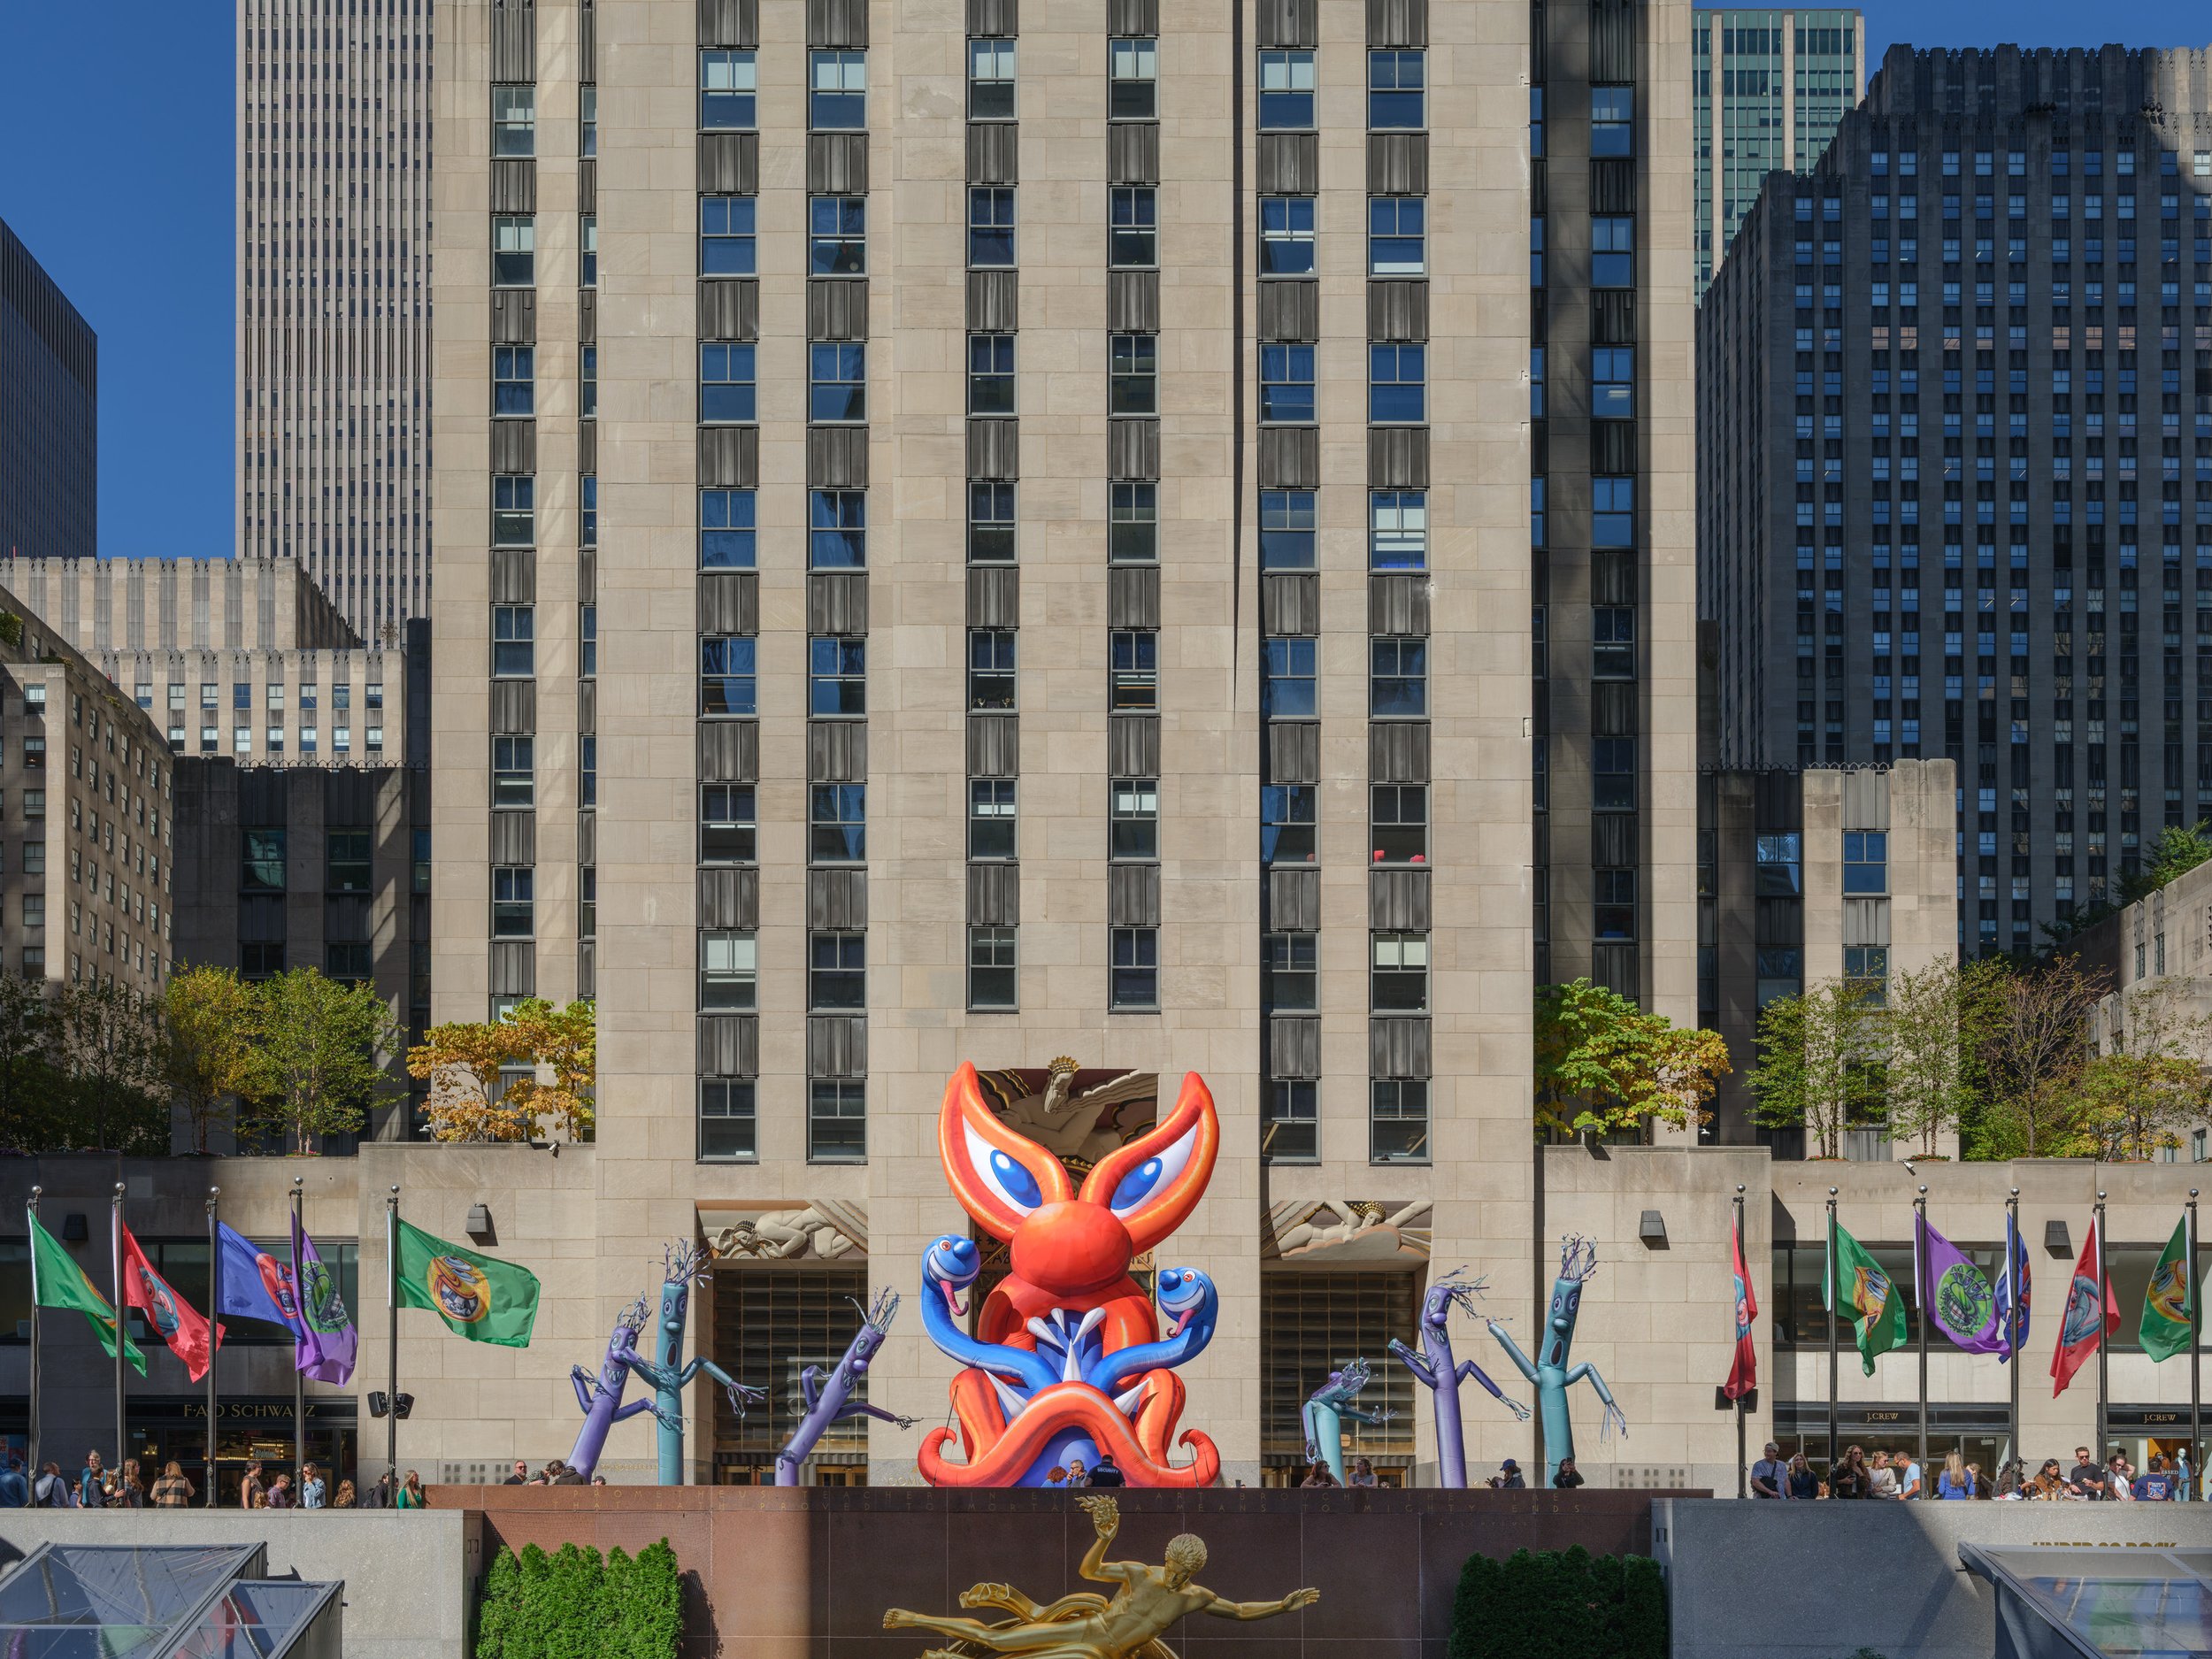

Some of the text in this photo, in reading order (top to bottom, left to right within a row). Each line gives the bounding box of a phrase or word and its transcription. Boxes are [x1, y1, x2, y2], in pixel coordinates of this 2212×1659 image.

[232, 1404, 315, 1417] SCHWAZ
[1867, 1412, 1899, 1423] J.CREW
[2144, 1414, 2176, 1424] J.CREW
[573, 1490, 766, 1499] PROMETHEUS
[802, 1491, 933, 1500] TEACHER
[1156, 1492, 1203, 1501] ART
[1407, 1493, 1454, 1502] THE
[1490, 1493, 1558, 1502] FIRE
[553, 1502, 620, 1510] THAT
[760, 1502, 870, 1511] PROVED
[968, 1503, 1079, 1512] MORTAL
[1176, 1504, 1266, 1513] MEANS
[1302, 1504, 1330, 1513] TO
[1512, 1504, 1580, 1513] ENDS
